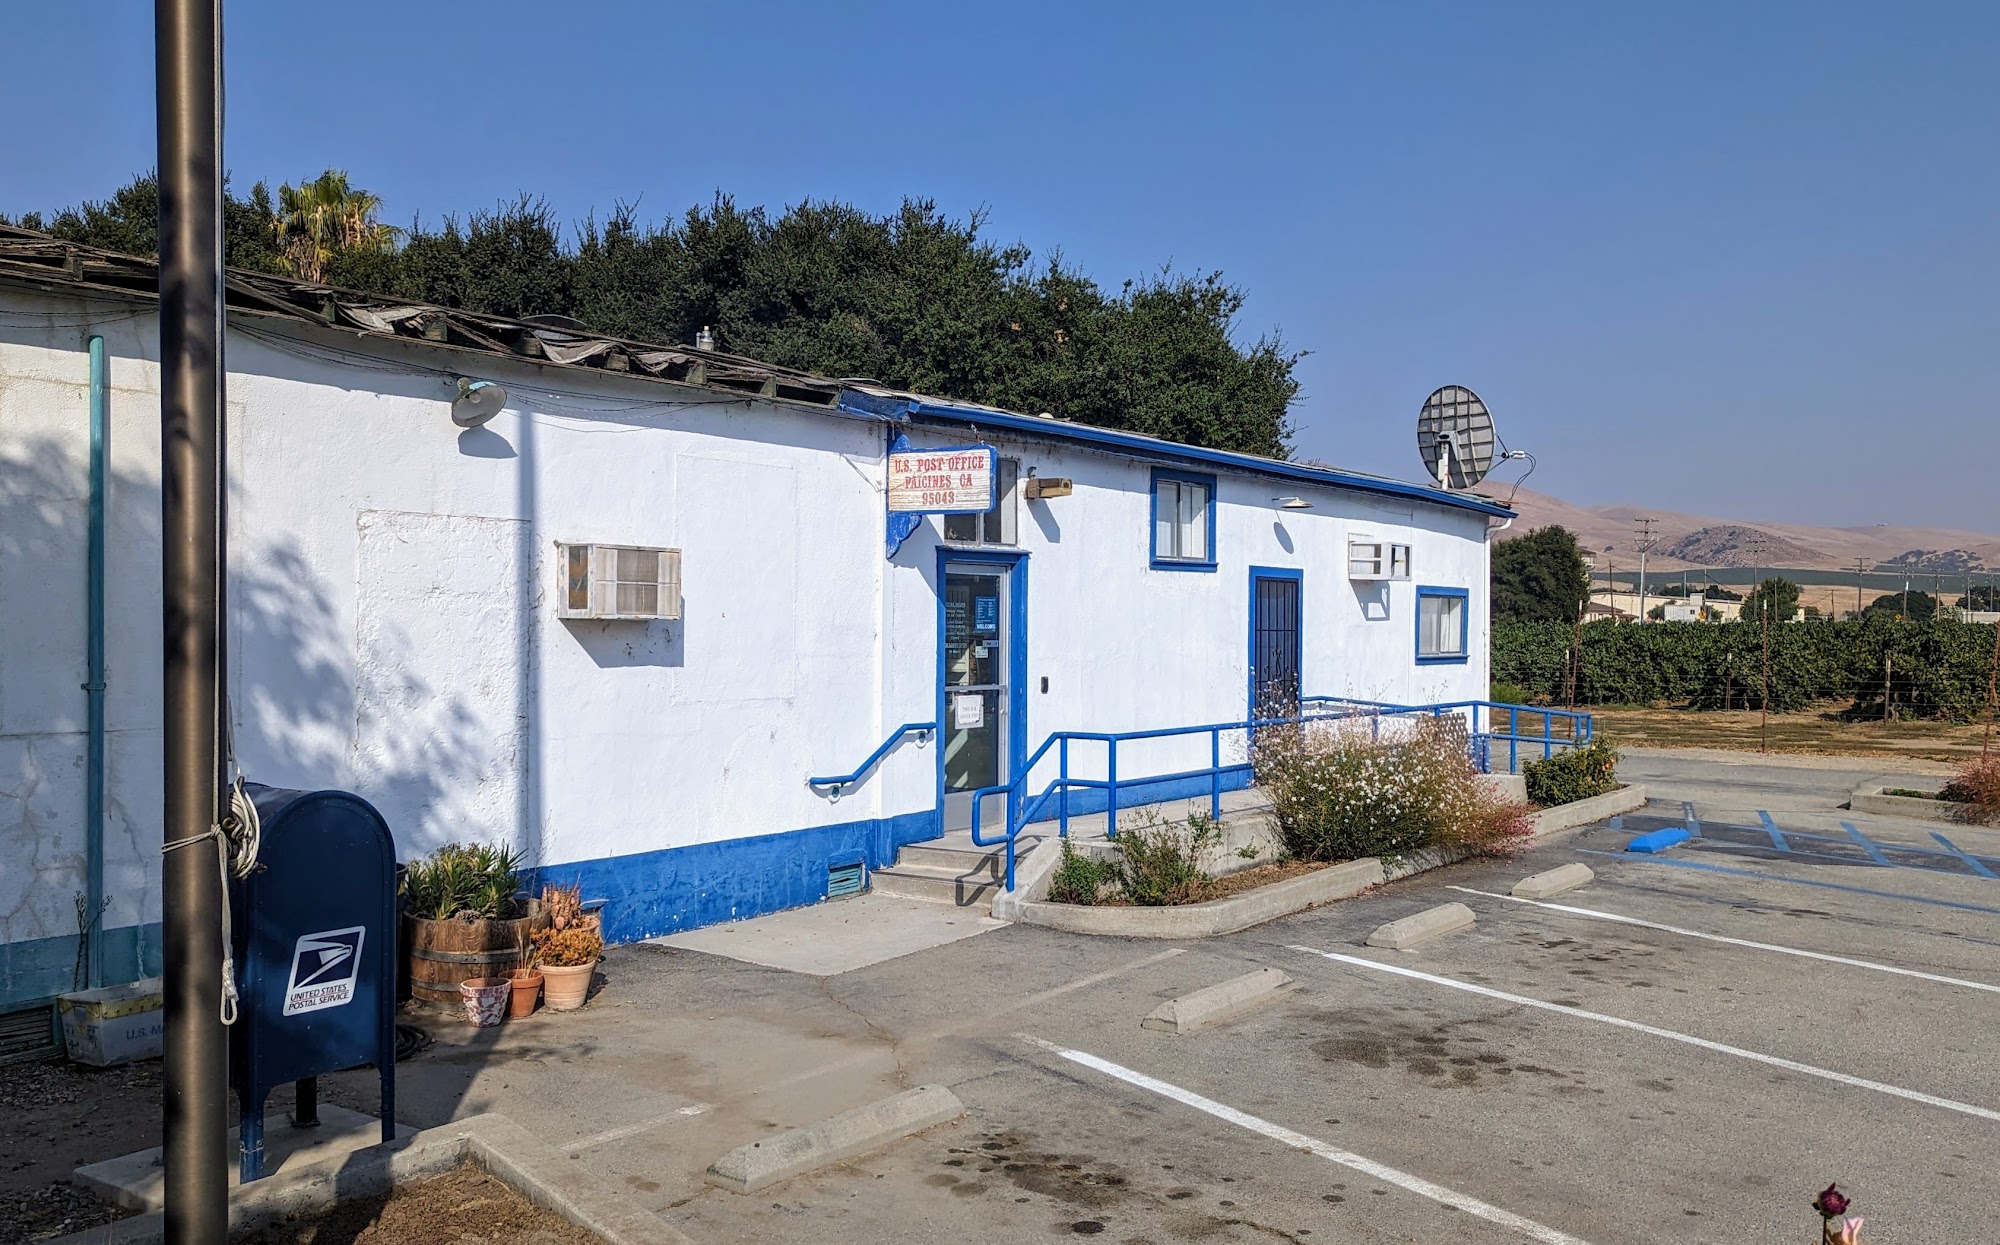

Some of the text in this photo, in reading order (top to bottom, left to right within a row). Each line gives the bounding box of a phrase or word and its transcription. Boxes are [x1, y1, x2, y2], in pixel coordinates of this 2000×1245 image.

[895, 455, 984, 473] U.S. POST OFFICE
[905, 473, 973, 489] PAICINES CA
[922, 491, 955, 505] 95043
[291, 984, 347, 1001] UNITED STATES
[288, 993, 348, 1010] POSTAL SERVICE
[152, 1024, 163, 1036] M
